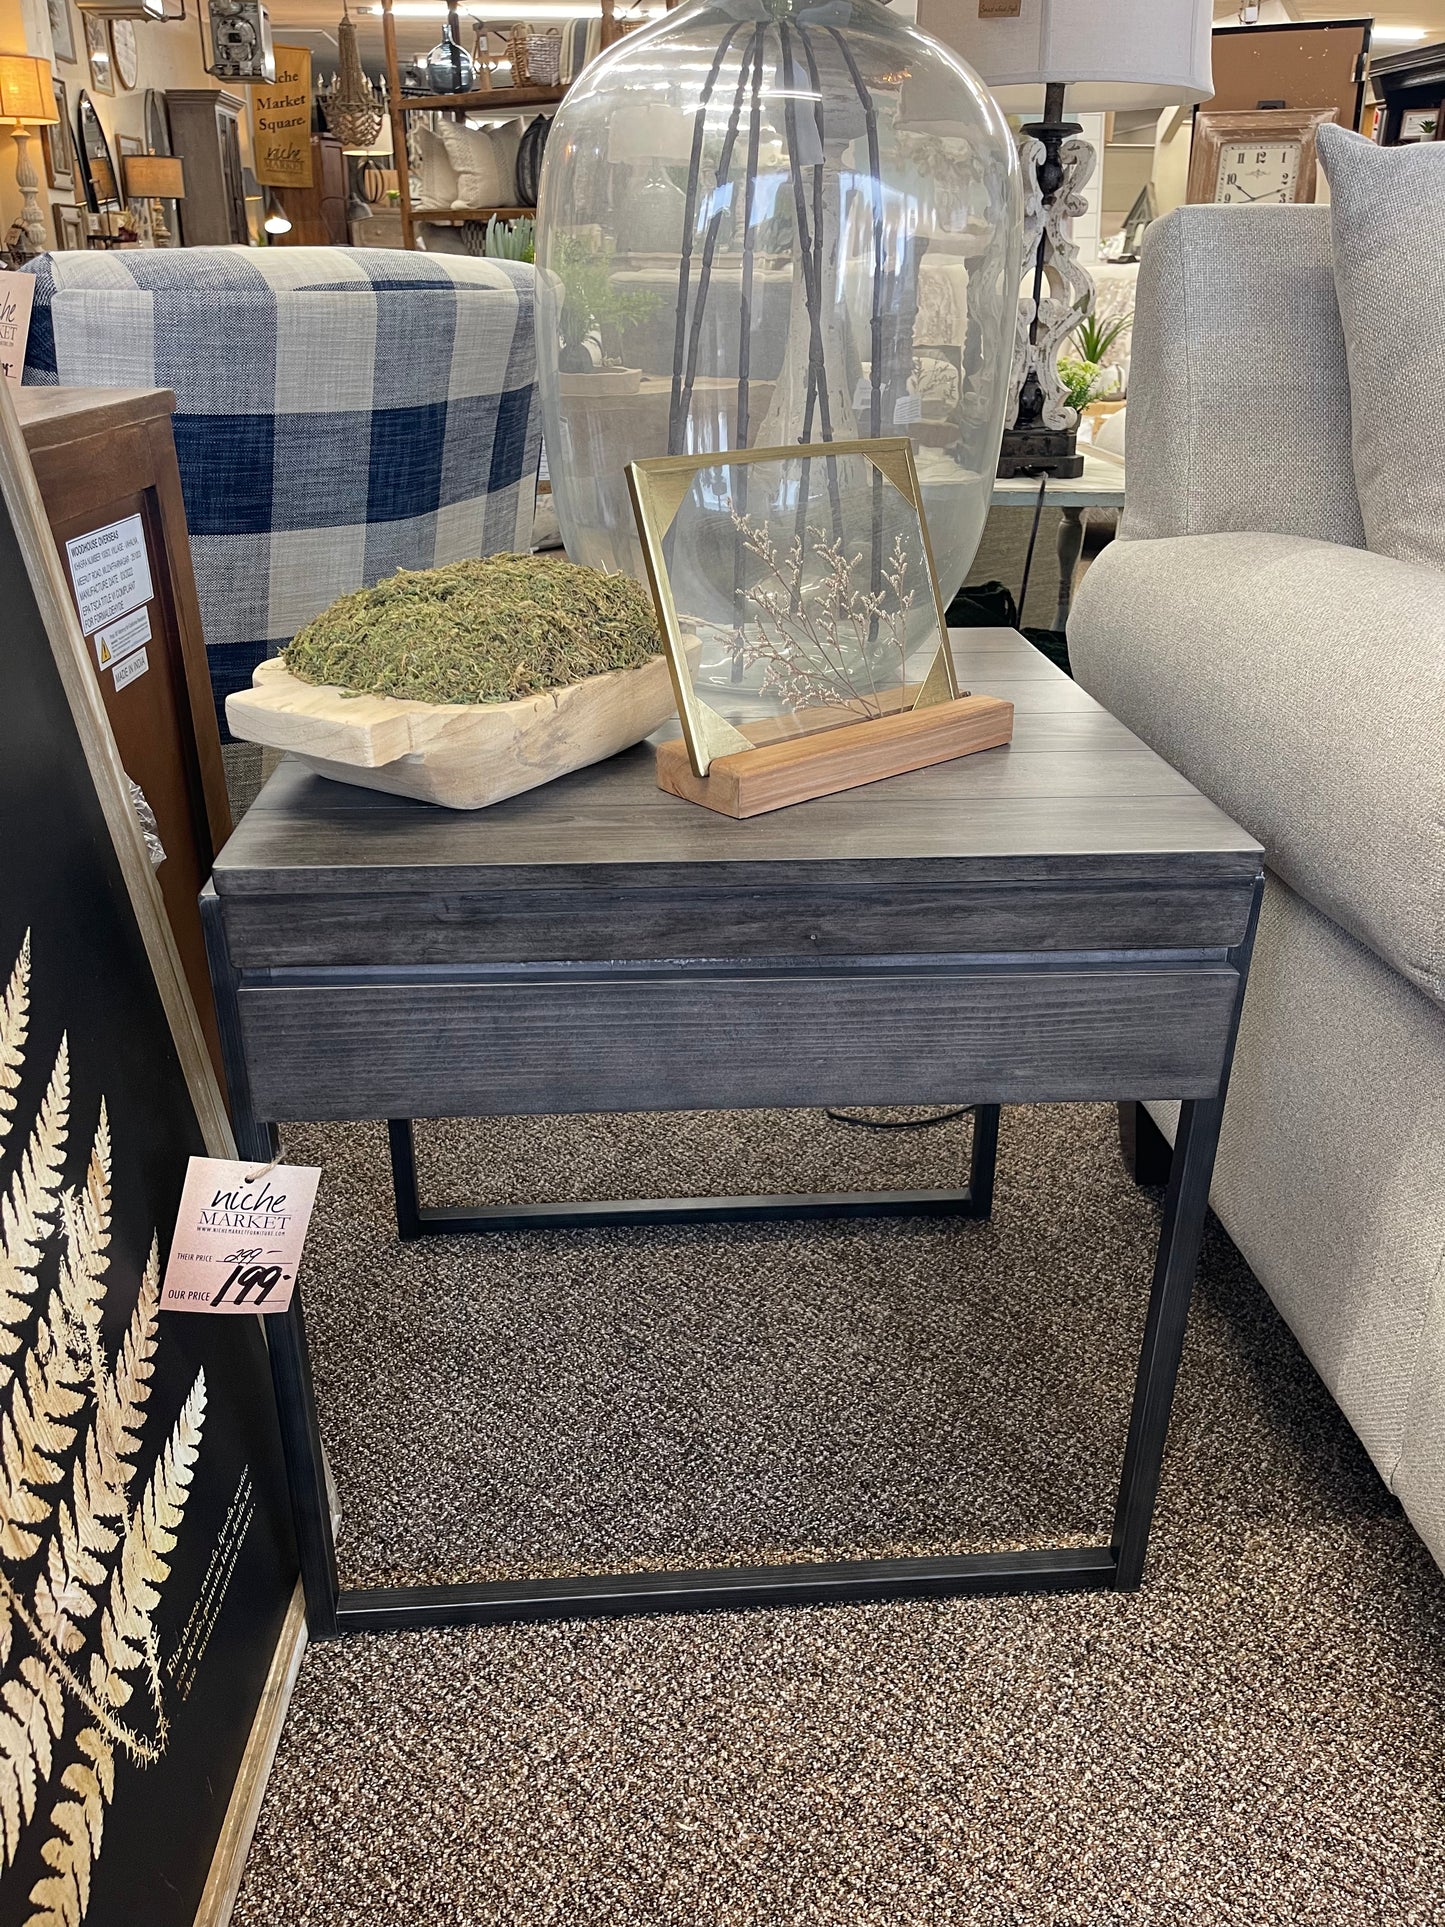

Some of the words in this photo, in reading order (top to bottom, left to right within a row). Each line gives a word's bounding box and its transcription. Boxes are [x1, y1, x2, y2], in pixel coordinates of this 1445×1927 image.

[276, 71, 298, 83] che
[257, 96, 306, 110] Market
[1237, 152, 1244, 163] 11
[1256, 152, 1266, 163] 12
[1281, 152, 1286, 163] 1
[1227, 173, 1236, 184] 10
[1281, 173, 1288, 184] 2
[1224, 194, 1231, 203] 9
[1279, 193, 1286, 203] 3
[71, 538, 98, 557] WOODHOUSE
[98, 530, 119, 546] OVERSEAS
[79, 579, 109, 601] MANUFACTURE
[85, 617, 94, 630] FOR
[94, 601, 124, 625] FORMALDEHYDE
[115, 666, 128, 683] MADE
[127, 663, 133, 674] IN
[133, 655, 146, 671] INDIA
[211, 1183, 287, 1213] niche
[199, 1212, 291, 1229] MARKET
[197, 1226, 285, 1236] WWW.NICHEMARKETFURNITURE.COM
[168, 1289, 185, 1300] OUR
[188, 1291, 210, 1301] PRICE
[165, 1643, 182, 1678] Filix
[176, 1662, 187, 1690] non
